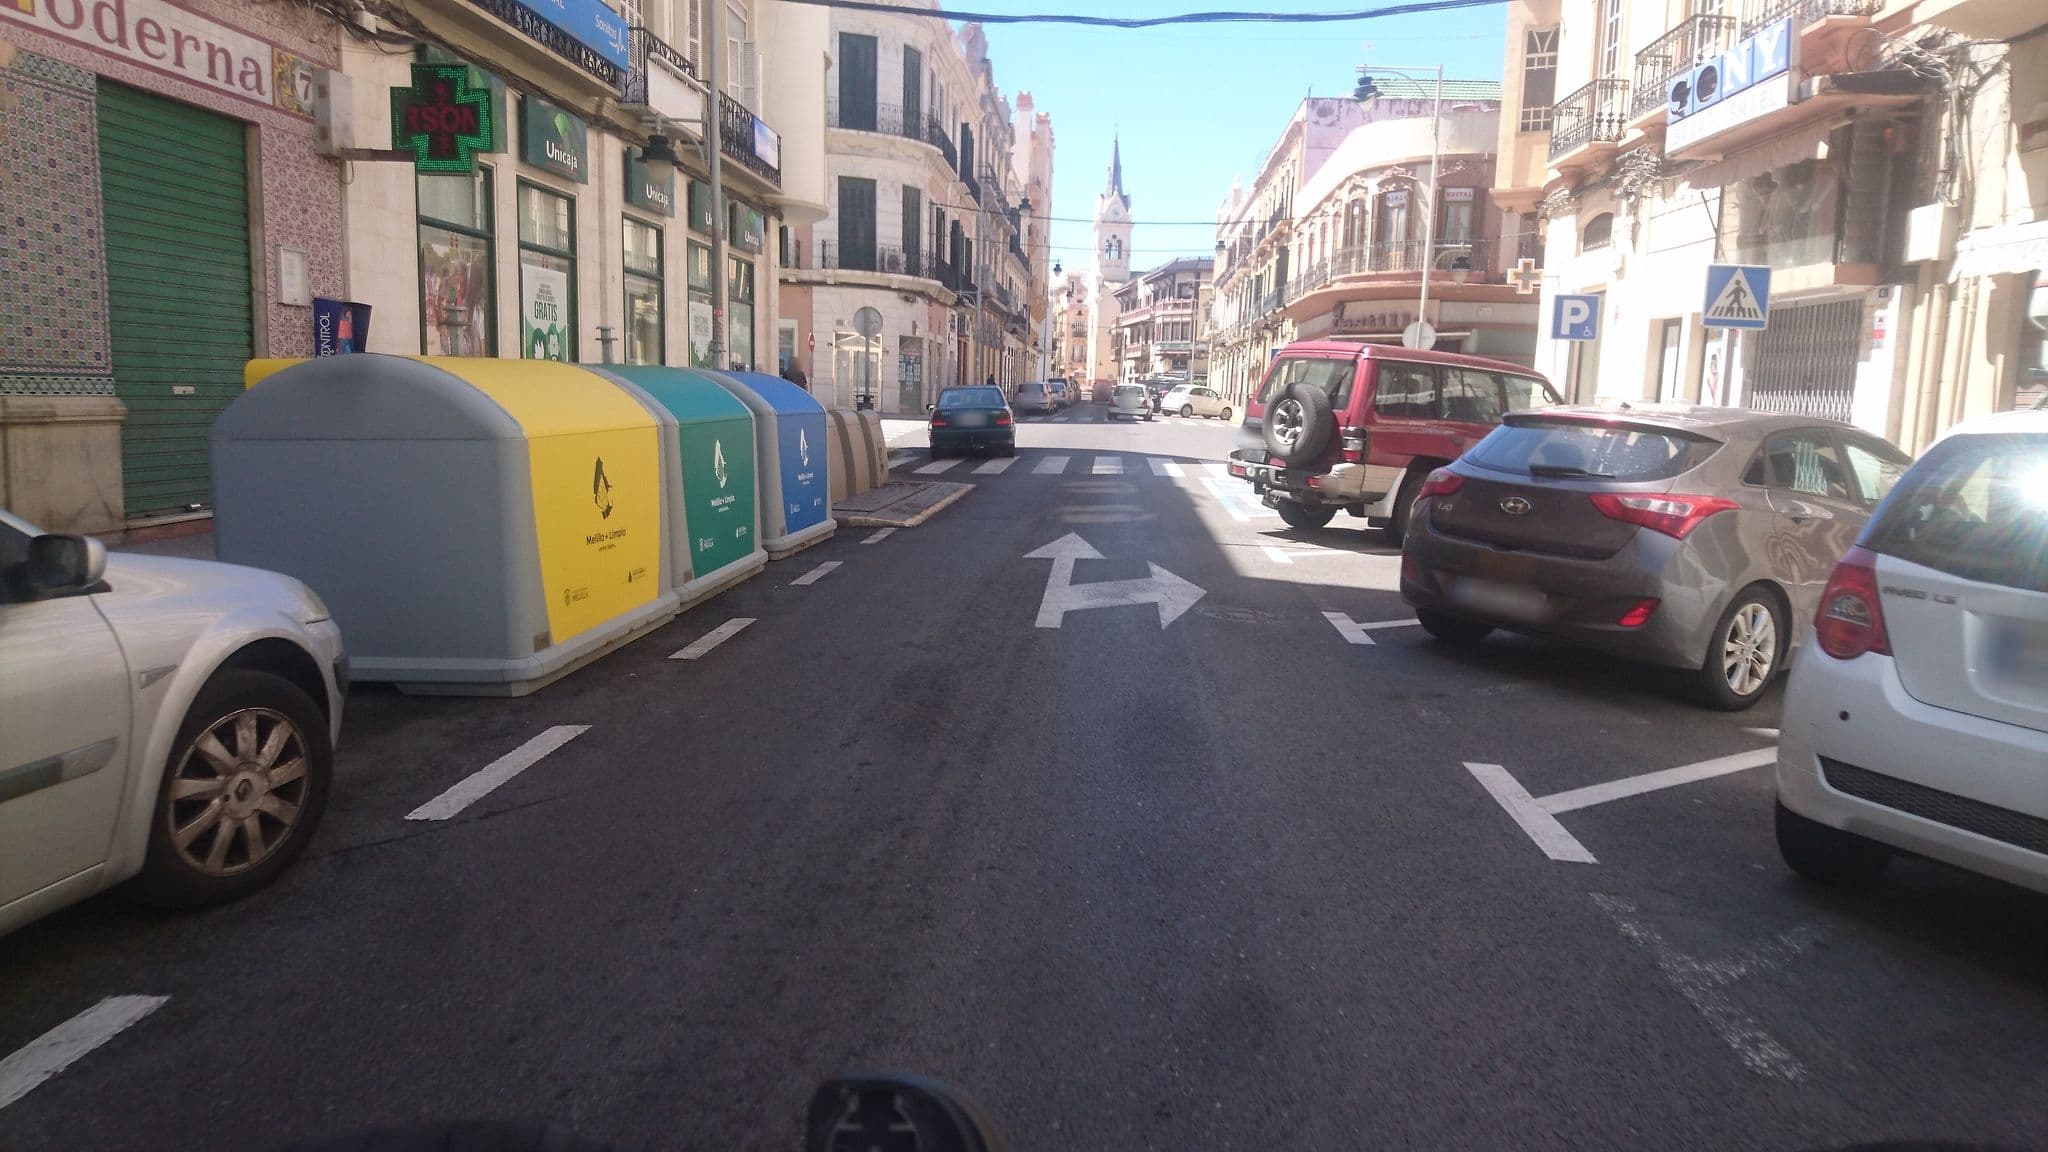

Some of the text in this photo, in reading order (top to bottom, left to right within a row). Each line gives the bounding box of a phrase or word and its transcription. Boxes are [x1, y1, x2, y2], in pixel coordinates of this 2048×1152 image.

[18, 0, 267, 97] oderna
[546, 140, 578, 171] Unicaja
[534, 301, 558, 322] GRATIS
[1560, 299, 1590, 335] P
